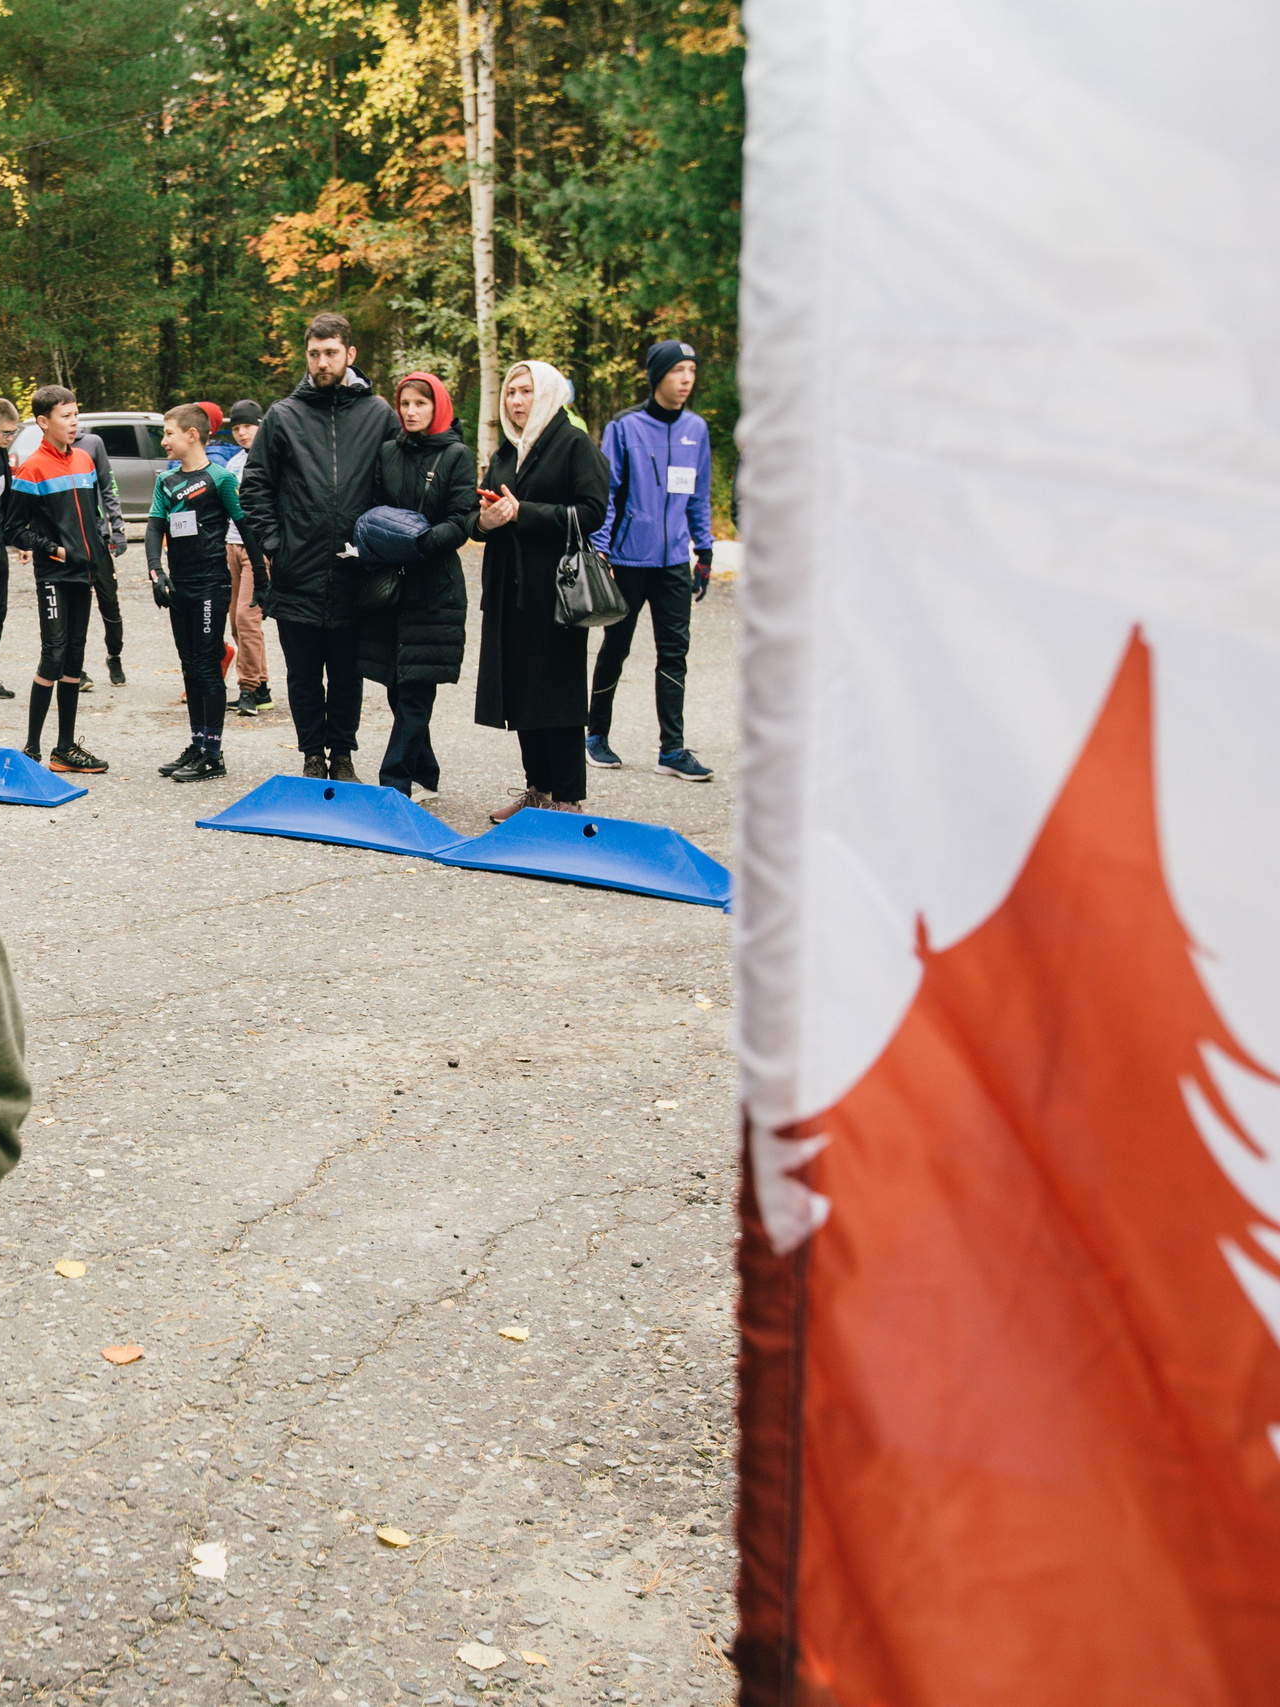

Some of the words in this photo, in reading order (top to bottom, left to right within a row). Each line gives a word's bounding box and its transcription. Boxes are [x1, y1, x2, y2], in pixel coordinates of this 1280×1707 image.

[177, 480, 207, 500] O-UGRA
[174, 520, 187, 530] 107
[45, 582, 58, 619] ГРА
[202, 600, 212, 634] O-UGRA
[207, 733, 222, 741] FIL
